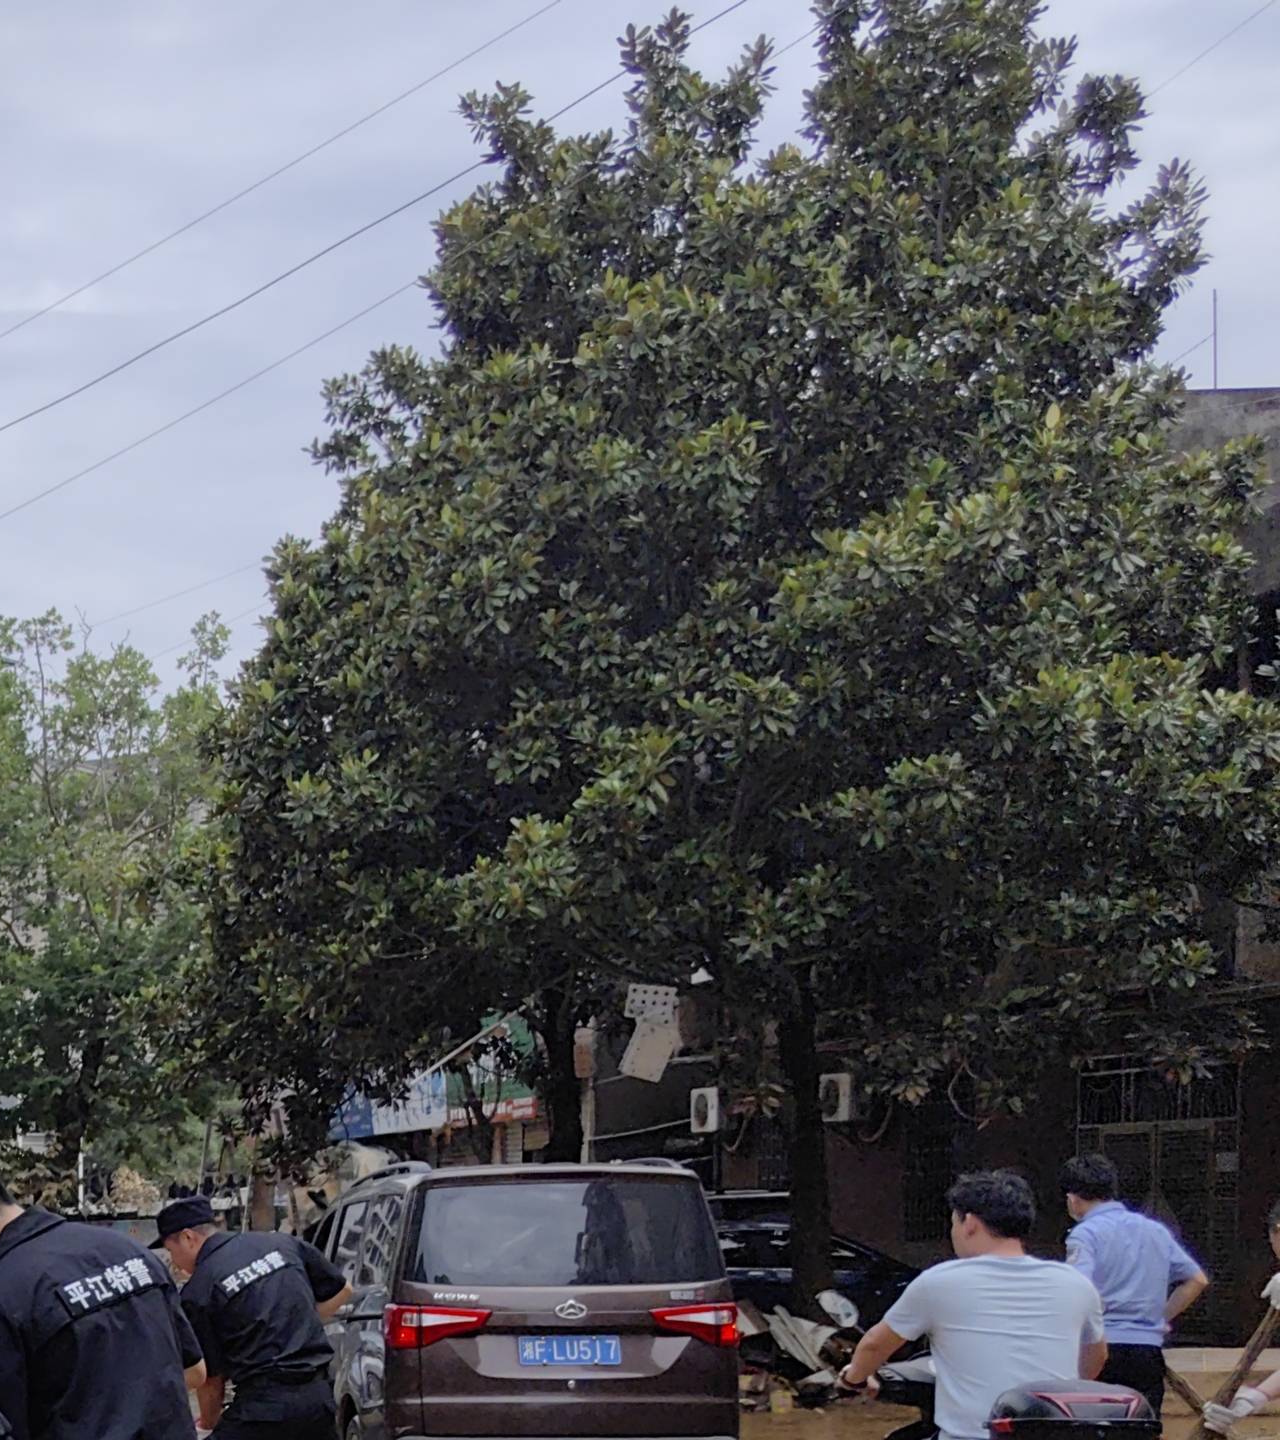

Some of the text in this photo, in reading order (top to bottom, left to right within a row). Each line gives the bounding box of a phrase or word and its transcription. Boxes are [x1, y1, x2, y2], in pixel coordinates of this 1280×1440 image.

[63, 1257, 154, 1310] 平江特警
[220, 1250, 287, 1294] 平江特警
